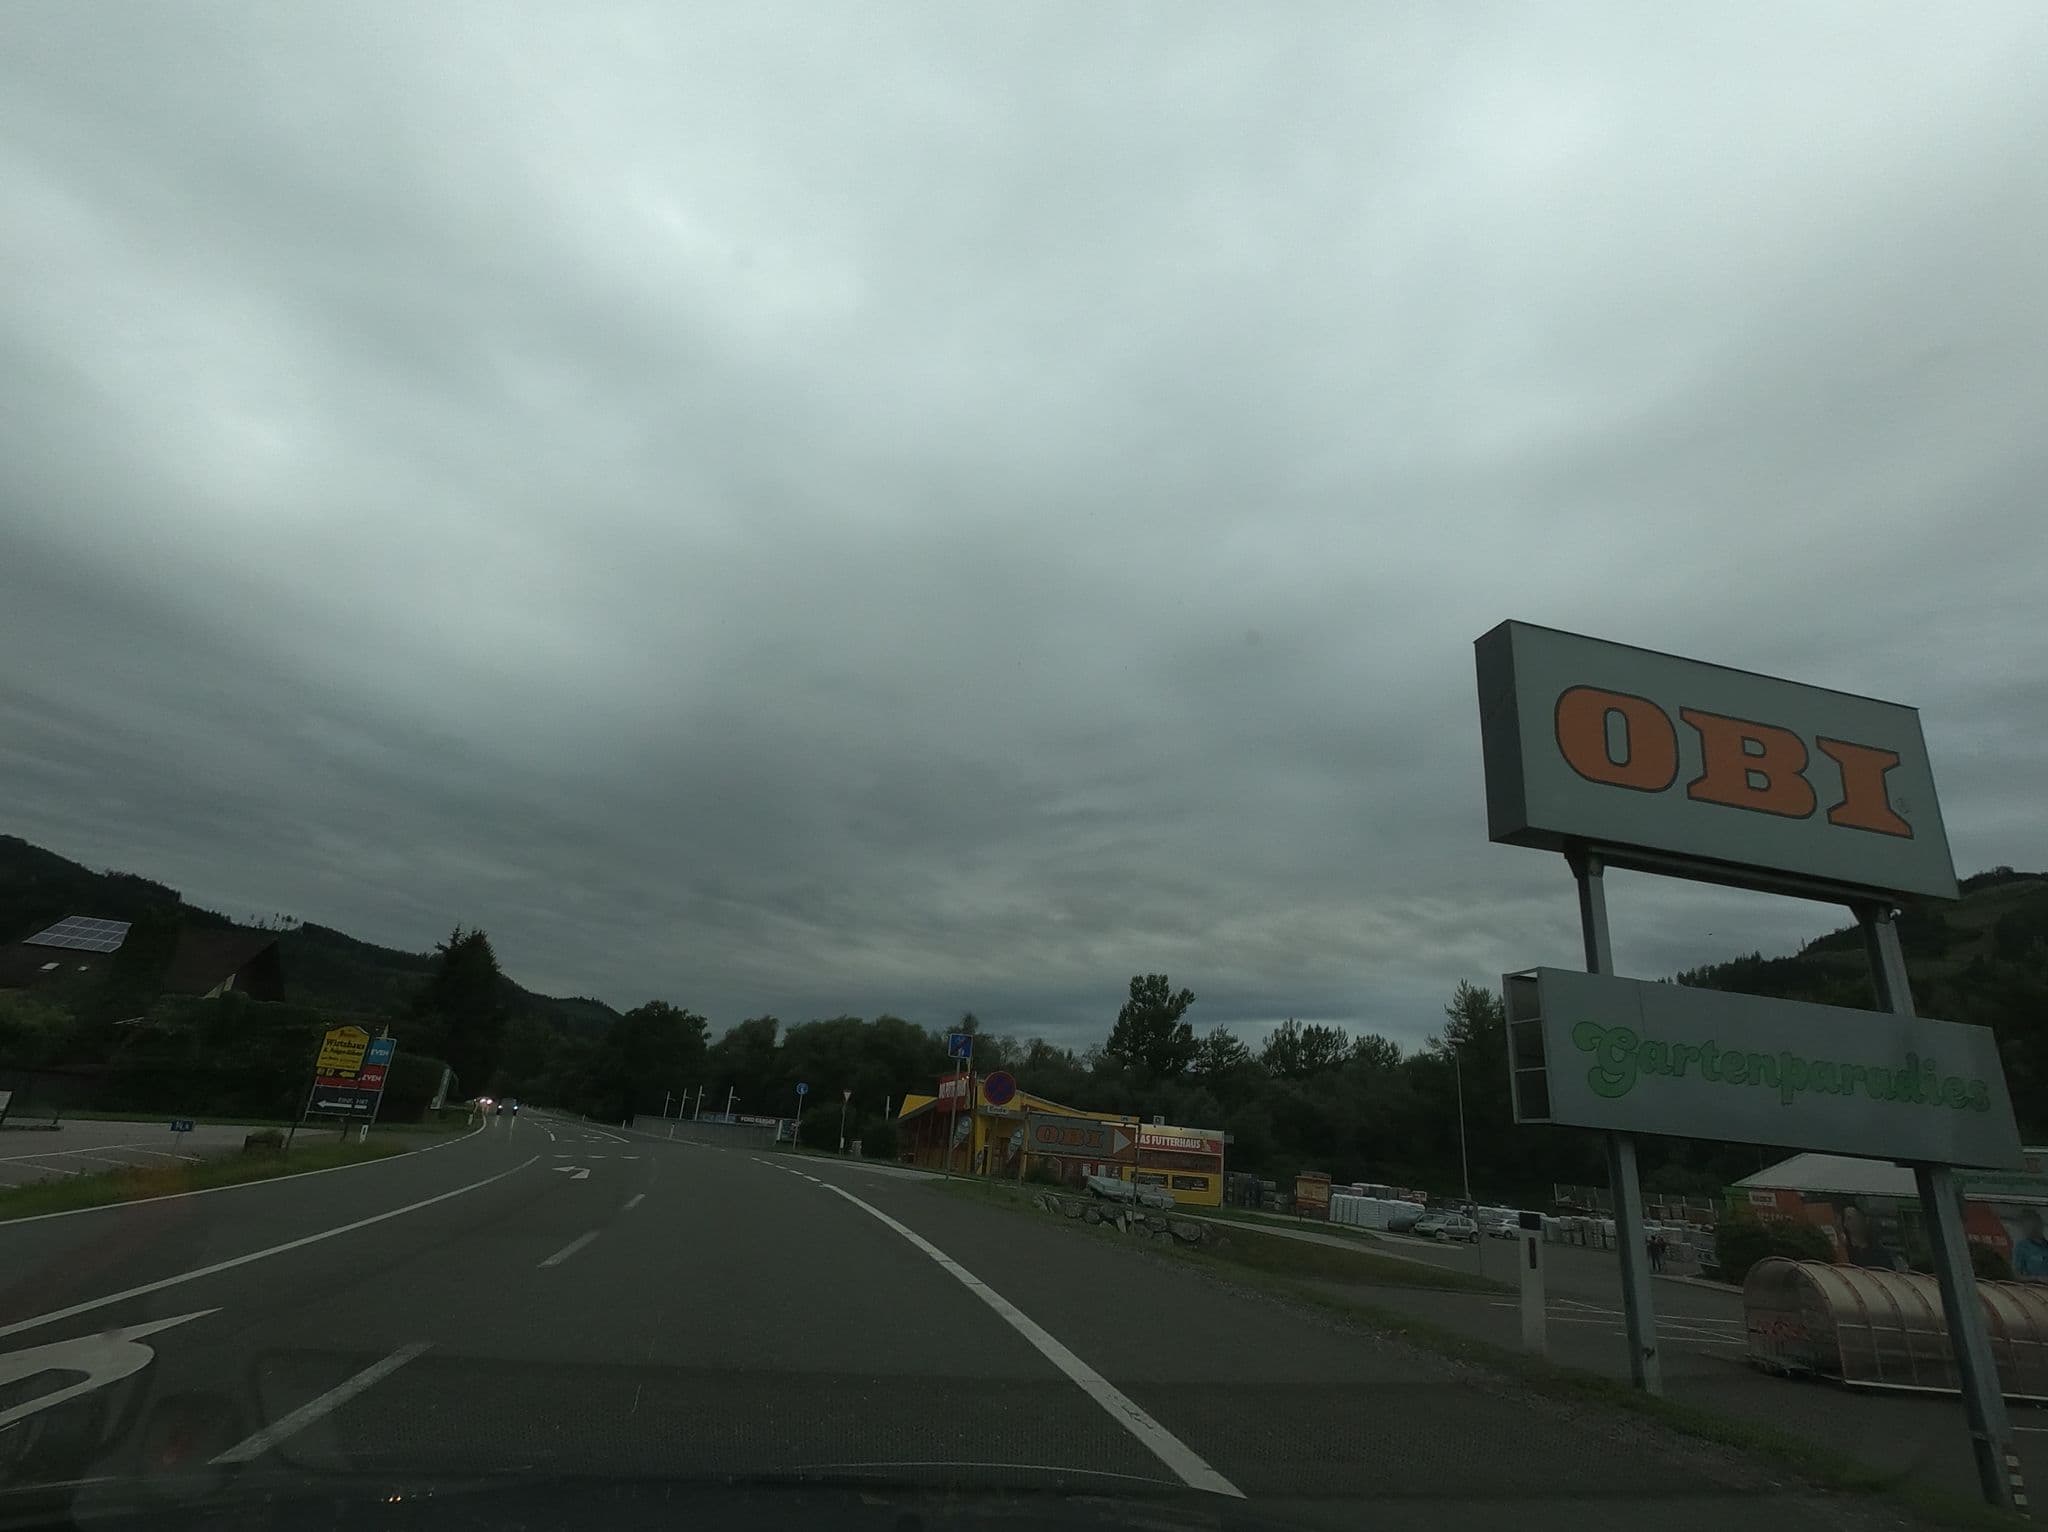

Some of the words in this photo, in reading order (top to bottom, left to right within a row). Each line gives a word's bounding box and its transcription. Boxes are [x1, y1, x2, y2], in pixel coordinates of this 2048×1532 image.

[1555, 685, 1914, 840] OBI
[1571, 1021, 1991, 1112] Gartenparadies
[1036, 1125, 1104, 1148] OBI
[1152, 1136, 1201, 1149] FUTTERHAUS
